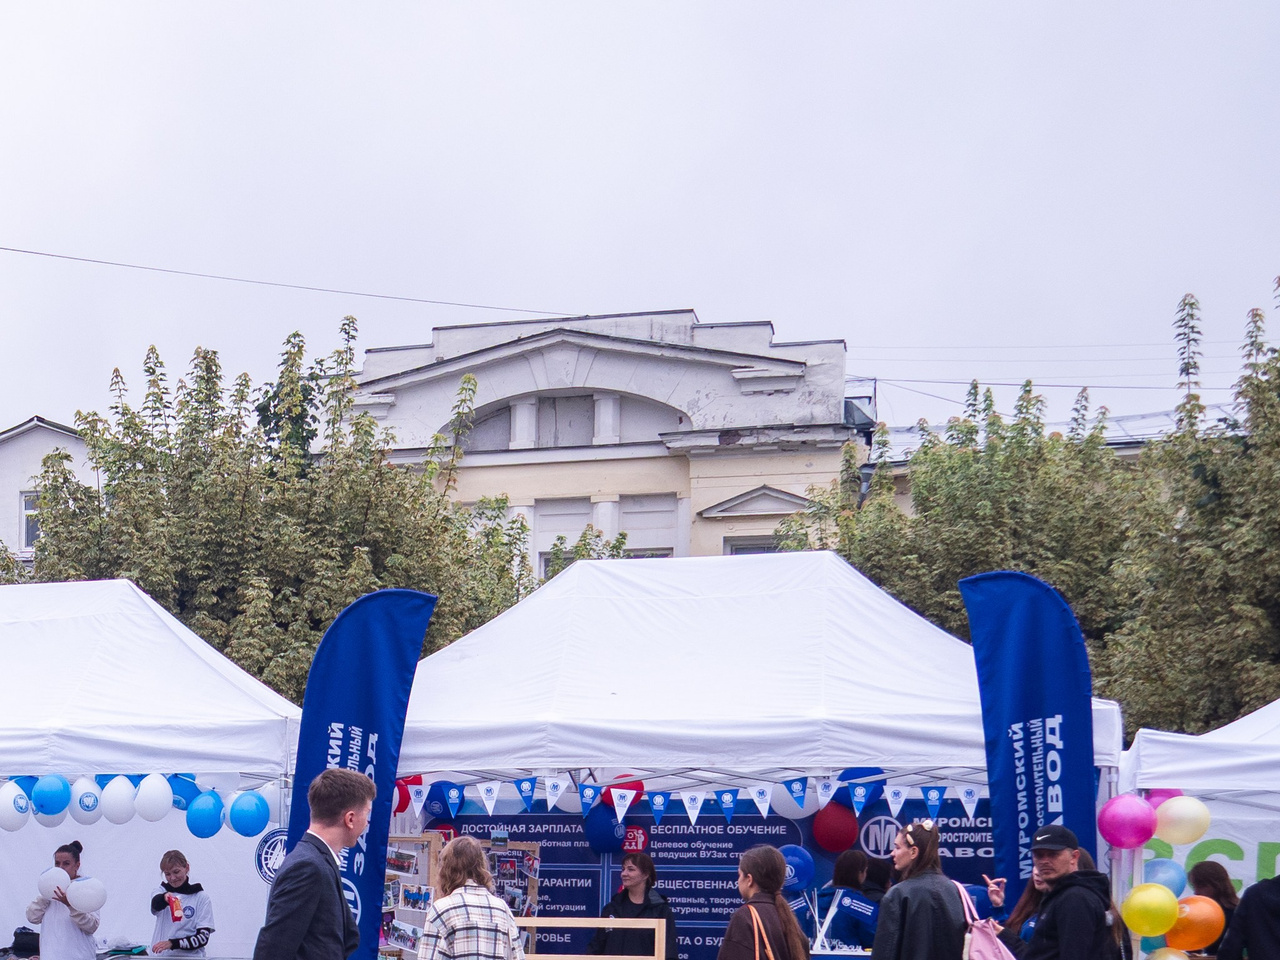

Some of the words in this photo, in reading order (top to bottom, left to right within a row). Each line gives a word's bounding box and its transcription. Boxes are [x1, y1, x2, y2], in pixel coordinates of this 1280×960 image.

[1008, 722, 1033, 880] МУРОМСКИЙ
[461, 822, 526, 834] ДОСТОЙНАЯ
[528, 824, 584, 834] ЗАРПЛАТА
[650, 825, 724, 835] БЕСПЛАТНОЕ
[726, 825, 787, 835] ОБУЧЕНИЕ
[650, 841, 689, 850] Целевое
[690, 841, 733, 850] обучение
[657, 851, 698, 859] ведущих
[938, 847, 995, 858] АВО
[538, 878, 592, 888] ГАРАНТИИ
[651, 880, 739, 890] ОБЩЕСТВЕННАЯ
[671, 907, 710, 915] ьтурные
[535, 933, 571, 943] РОВЬЕ
